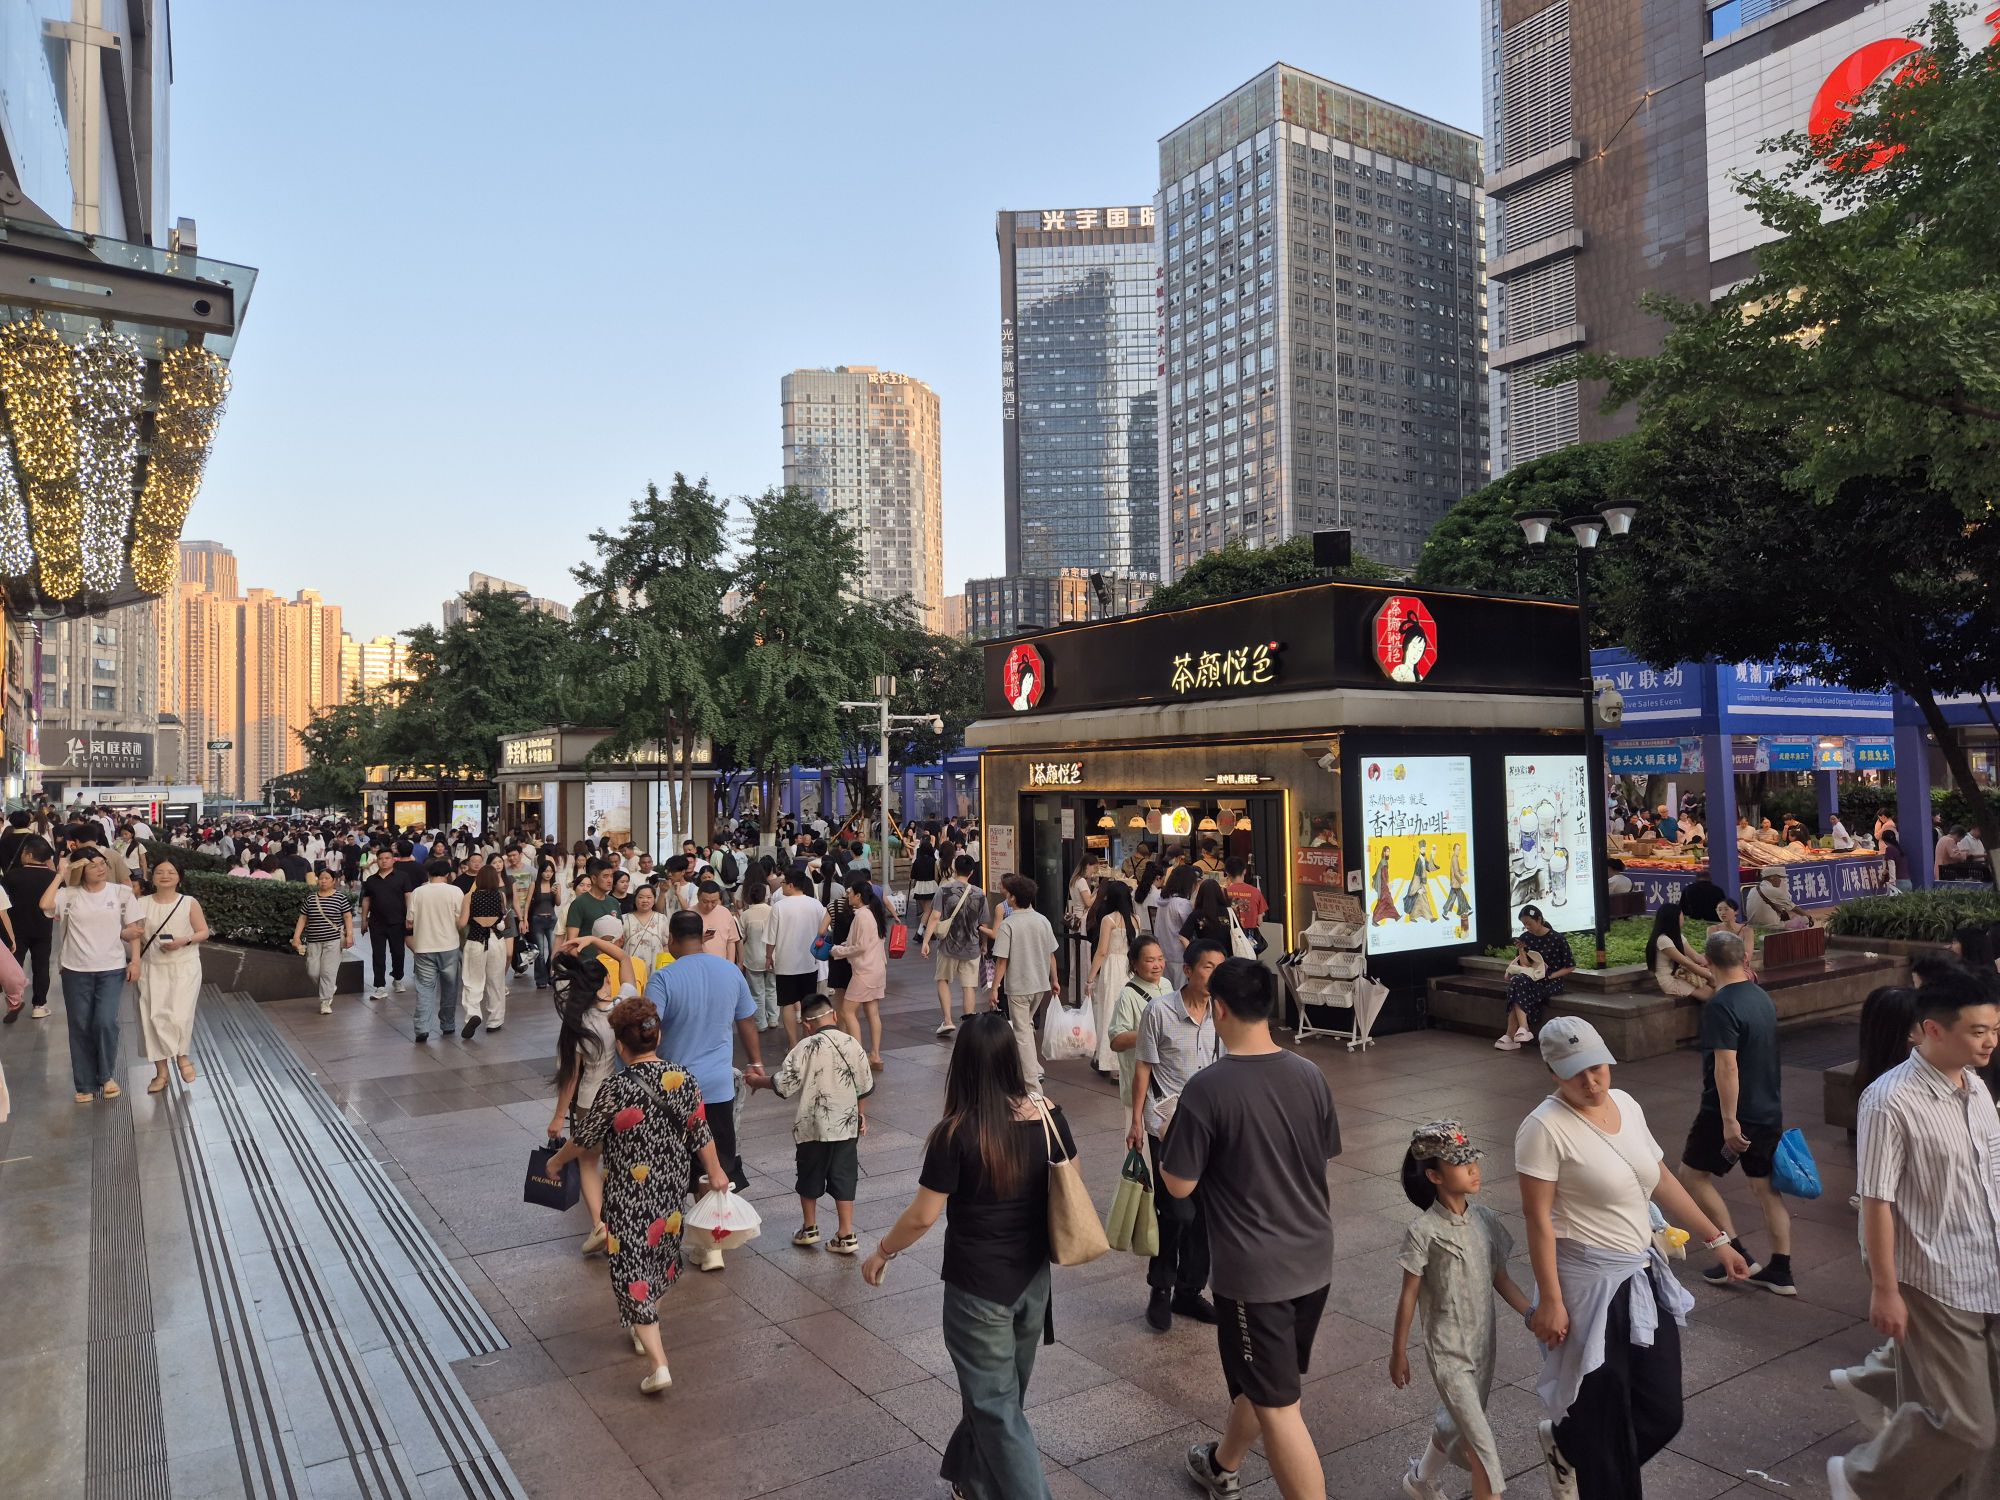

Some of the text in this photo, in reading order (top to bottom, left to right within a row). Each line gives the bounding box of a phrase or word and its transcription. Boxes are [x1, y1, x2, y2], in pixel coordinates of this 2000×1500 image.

[1002, 328, 1015, 420] 光宇戴斯酒店
[1171, 644, 1274, 694] 茶颜悦色
[1638, 700, 1658, 708] Sales
[1660, 698, 1682, 706] Event
[1836, 697, 1853, 706] Opening
[91, 741, 142, 756] 岚庭装饰
[1611, 753, 1678, 766] 桥头火锅底料
[1732, 755, 1754, 764] 优特产
[1298, 851, 1338, 867] 2.5元专区
[1788, 871, 1830, 901] 手撕兔
